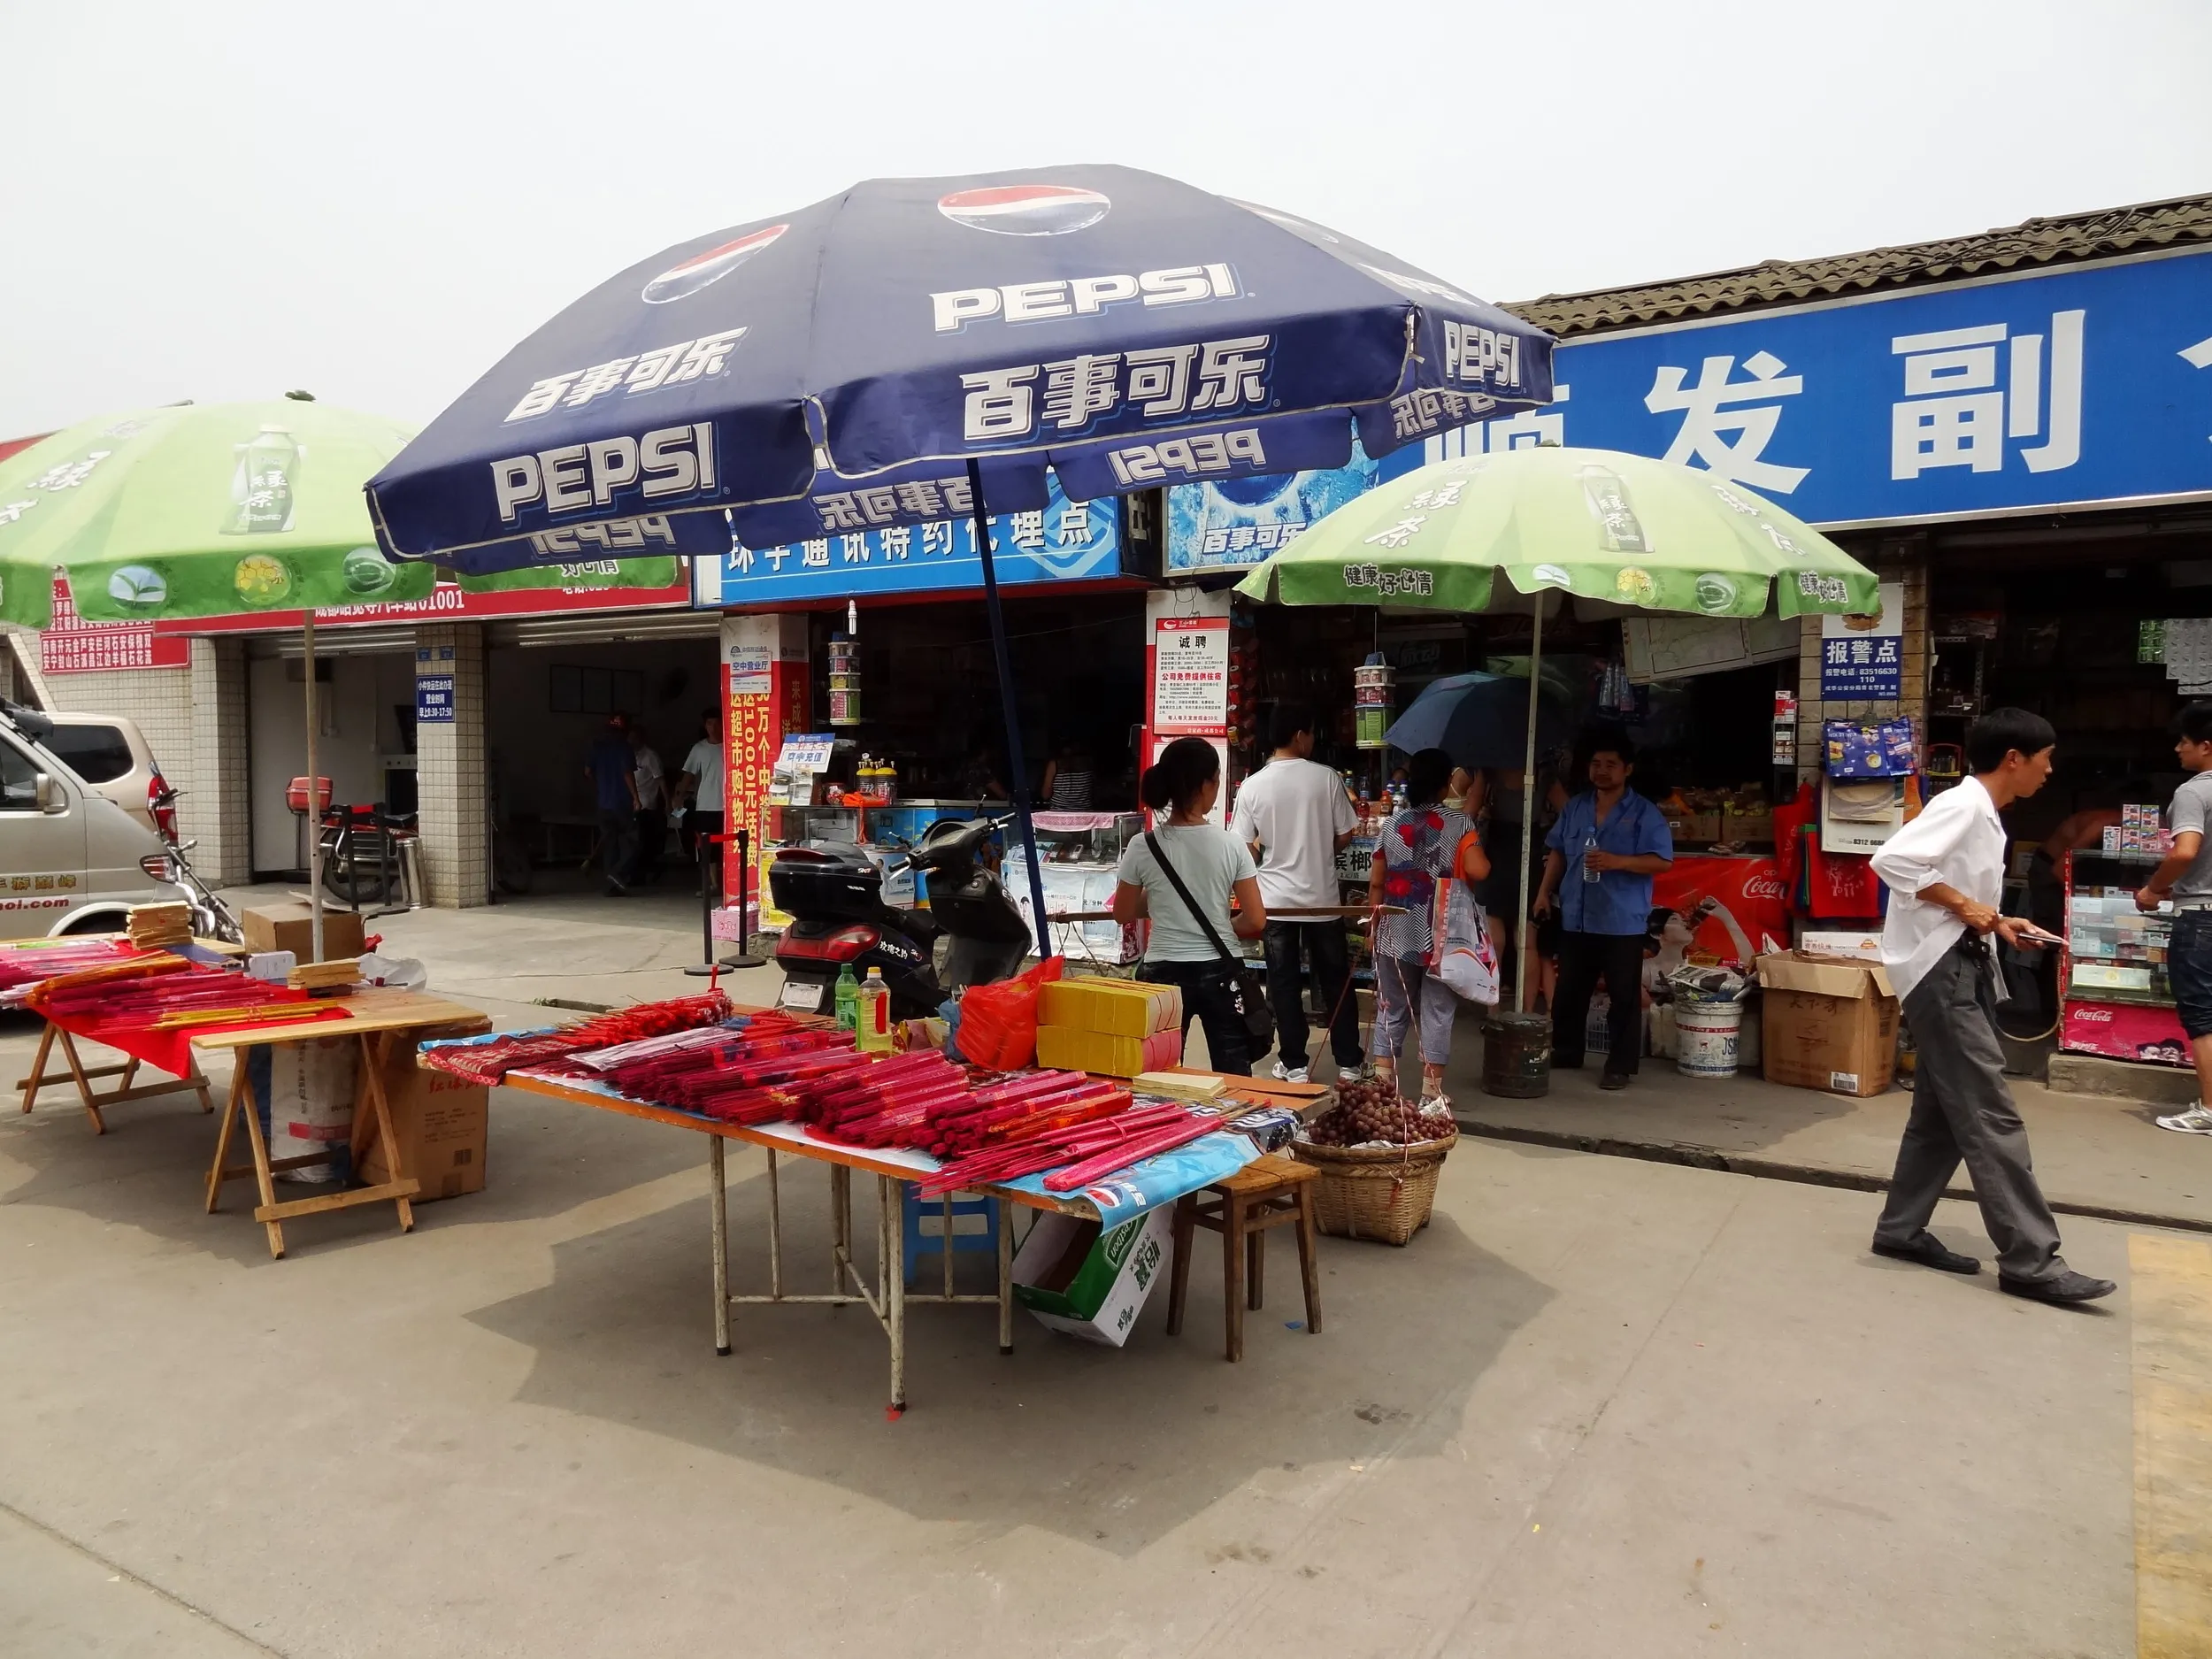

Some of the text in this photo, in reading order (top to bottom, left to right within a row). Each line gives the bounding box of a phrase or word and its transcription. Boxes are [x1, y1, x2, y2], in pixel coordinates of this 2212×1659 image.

[930, 263, 1237, 331] PEPSI
[1444, 320, 1520, 387] PEPSI
[503, 326, 749, 423] 百事可乐
[961, 334, 1271, 441] 百事可乐
[491, 422, 715, 522] PEPSI
[1202, 522, 1307, 554] 百事可乐
[1344, 563, 1432, 595] 健康好心情
[1179, 635, 1207, 649] 诚聘
[1827, 639, 1897, 664] 报警点
[733, 661, 768, 671] 空中营业厅
[426, 694, 445, 704] 营业时间
